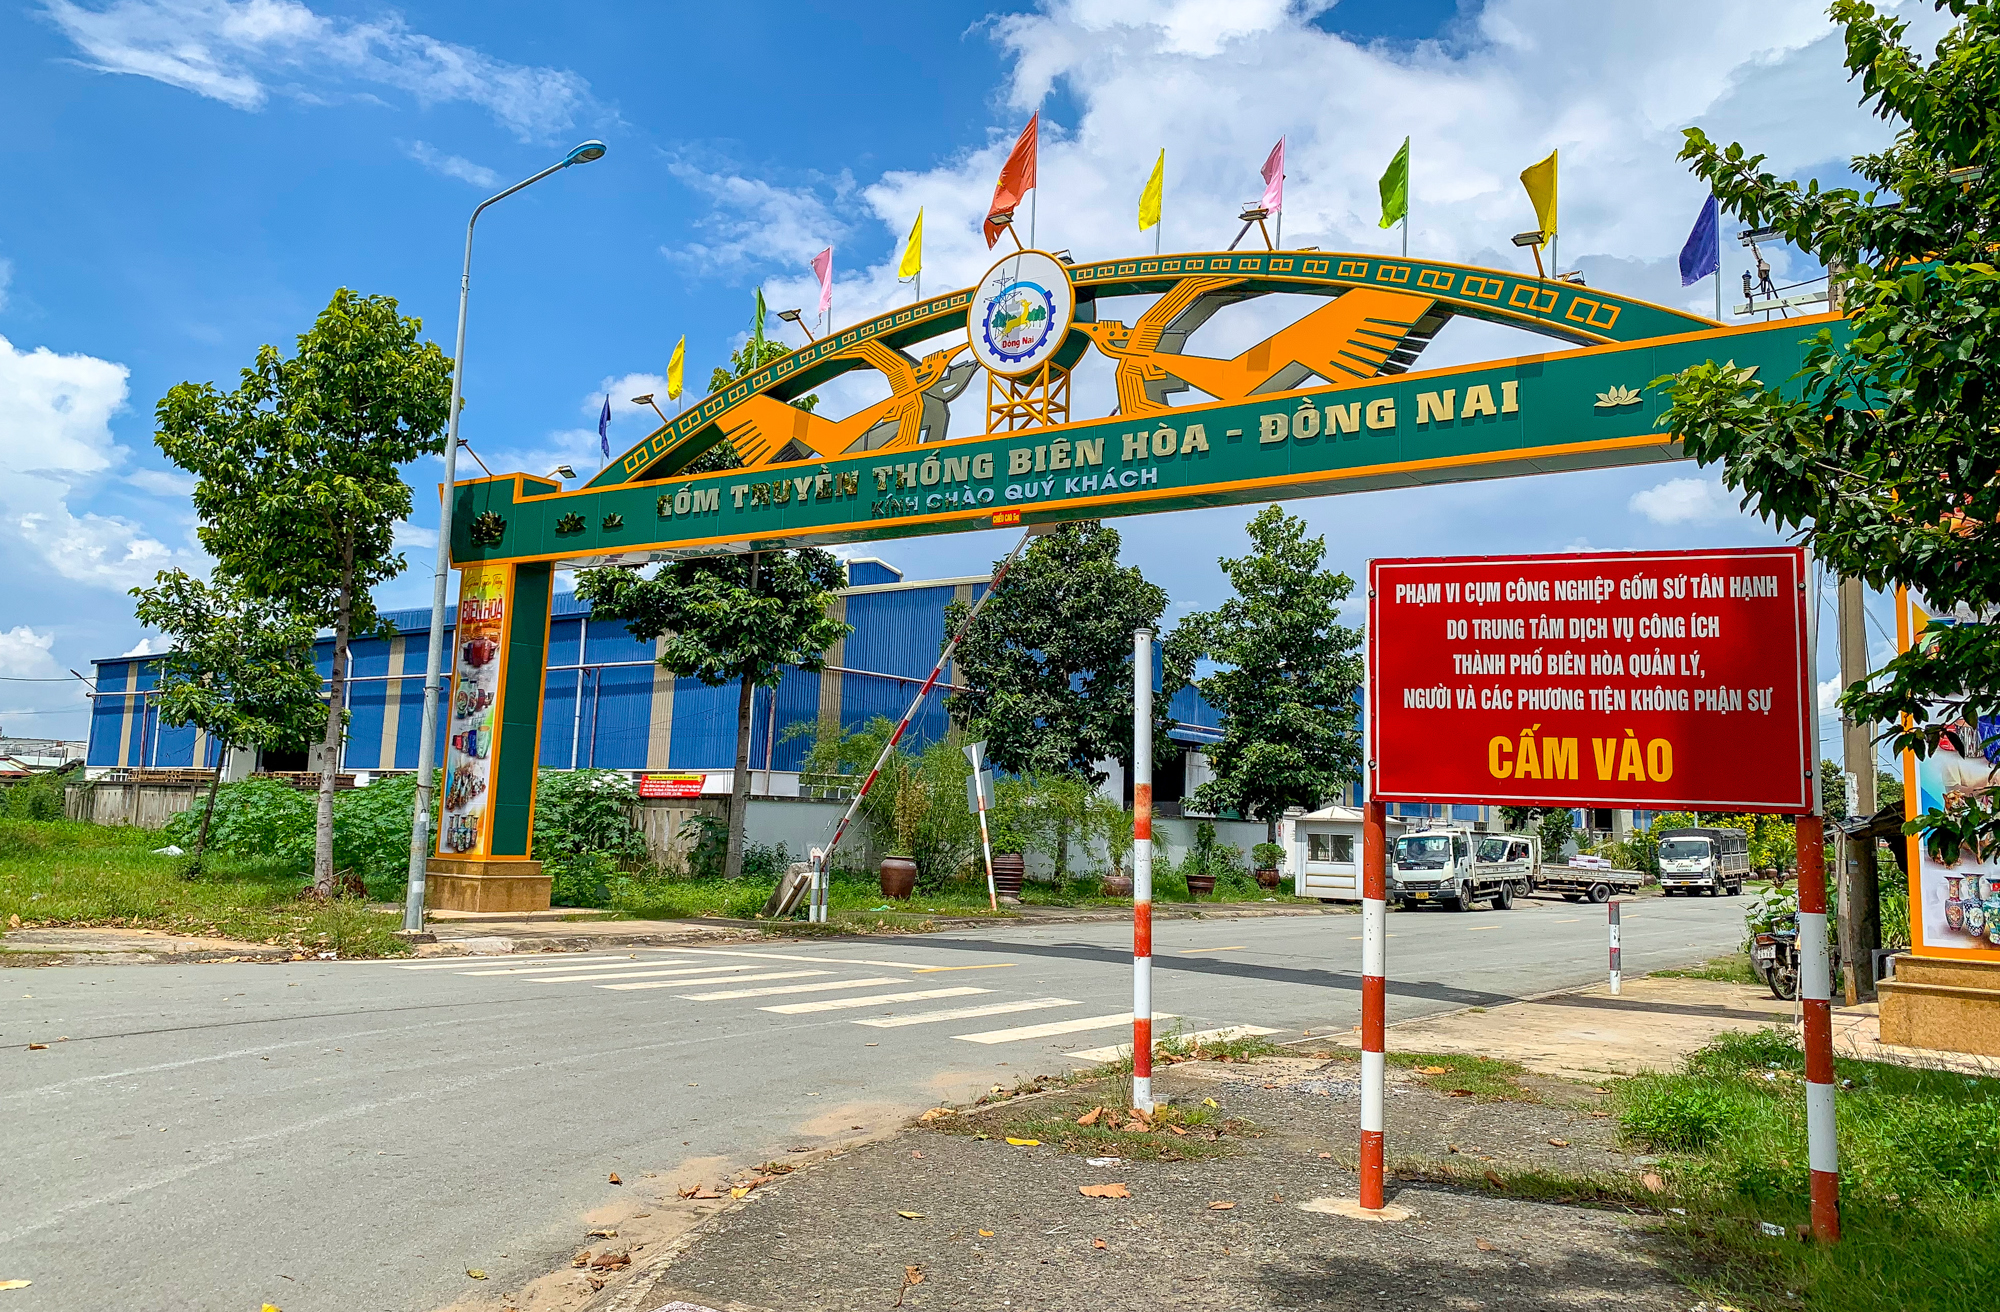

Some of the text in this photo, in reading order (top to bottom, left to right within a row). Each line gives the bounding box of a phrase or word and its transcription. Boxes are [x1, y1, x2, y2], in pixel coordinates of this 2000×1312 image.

[1022, 336, 1035, 345] Nai
[656, 482, 720, 517] GỐM
[730, 464, 859, 508] TRUYỀN
[872, 449, 994, 491] THỐNG
[1008, 438, 1105, 475] BIÊN
[1122, 422, 1209, 461] HÒA
[1259, 396, 1396, 443] ĐỒNG
[1416, 380, 1519, 424] NAI
[871, 467, 1158, 516] KÍNH CHÀO QUÝ KHÁCH
[1396, 572, 1777, 607] PHẠM VI CỤM CÔNG NGHIỆP GỐM SỨ TÂN HẠNH
[1447, 613, 1719, 642] DO TRUNG TÂM DỊCH VỤ CÔNG ÍCH
[1453, 647, 1704, 678] THÀNH PHỐ BIÊN HÒA QUẢN LÝ,
[1404, 683, 1773, 715] NGƯỜI VÀ CÁC PHƯƠNG TIỆN KHÔNG PHẬN SỰ
[1489, 724, 1672, 782] CẤM VÀO
